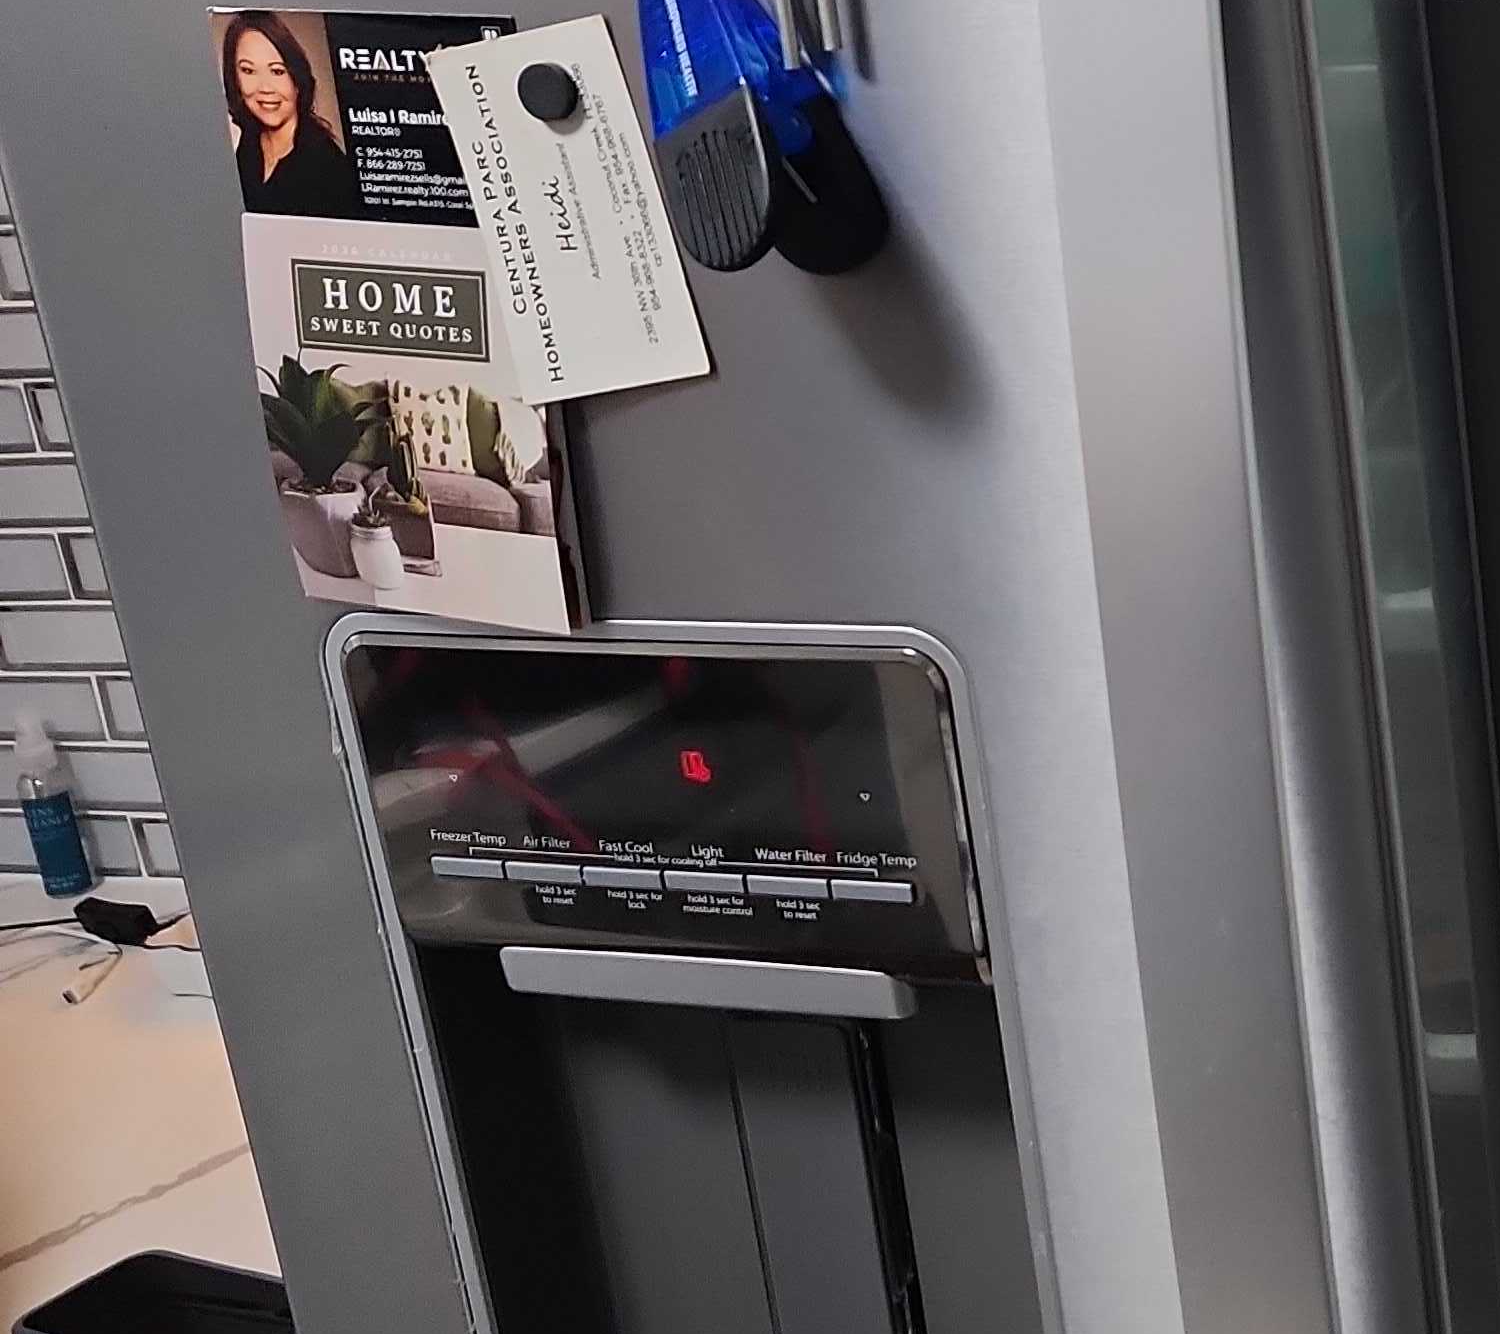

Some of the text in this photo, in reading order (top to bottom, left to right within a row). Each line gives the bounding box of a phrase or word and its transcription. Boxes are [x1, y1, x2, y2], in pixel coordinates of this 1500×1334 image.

[348, 107, 388, 123] Luisa
[541, 175, 578, 251] Heidi
[465, 65, 565, 382] HOMEOWNERS ASSOCIATION
[472, 140, 527, 315] CENTURA PARC
[322, 277, 456, 318] HOME
[310, 316, 473, 344] SWEET QUOTES
[430, 828, 507, 846] Freezer Temp
[523, 835, 571, 849] Air Filter
[599, 839, 653, 854] Fast Cool
[691, 843, 724, 859] Light
[754, 847, 827, 863] Water Filter
[614, 854, 634, 863] hold
[658, 855, 671, 864] for
[671, 857, 704, 868] cooling
[836, 851, 917, 869] Fridge Temp
